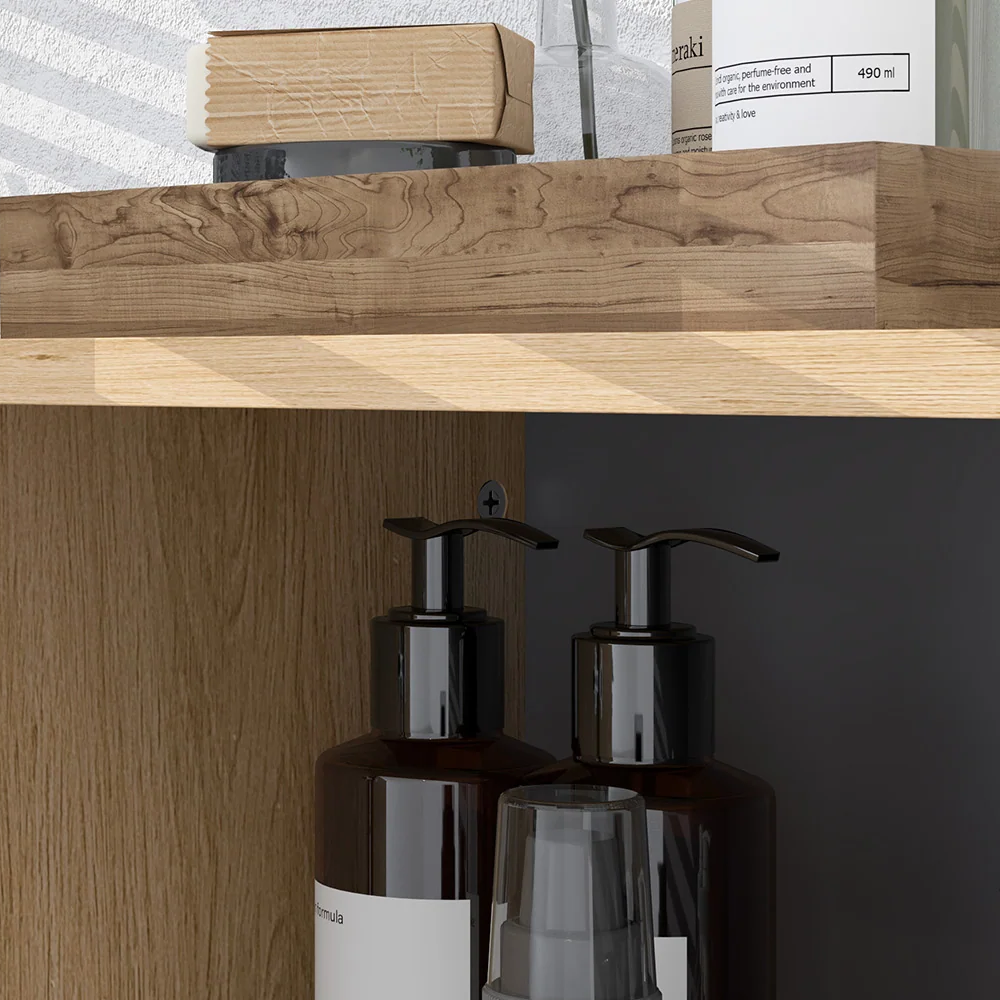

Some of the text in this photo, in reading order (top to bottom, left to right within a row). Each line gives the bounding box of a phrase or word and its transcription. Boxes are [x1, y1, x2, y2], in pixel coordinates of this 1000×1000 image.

[672, 35, 704, 63] eraki
[741, 65, 791, 81] perfume-free
[794, 63, 811, 74] and
[858, 67, 895, 79] 490 ml
[748, 83, 760, 92] the
[762, 78, 815, 91] environment
[741, 109, 756, 118] love
